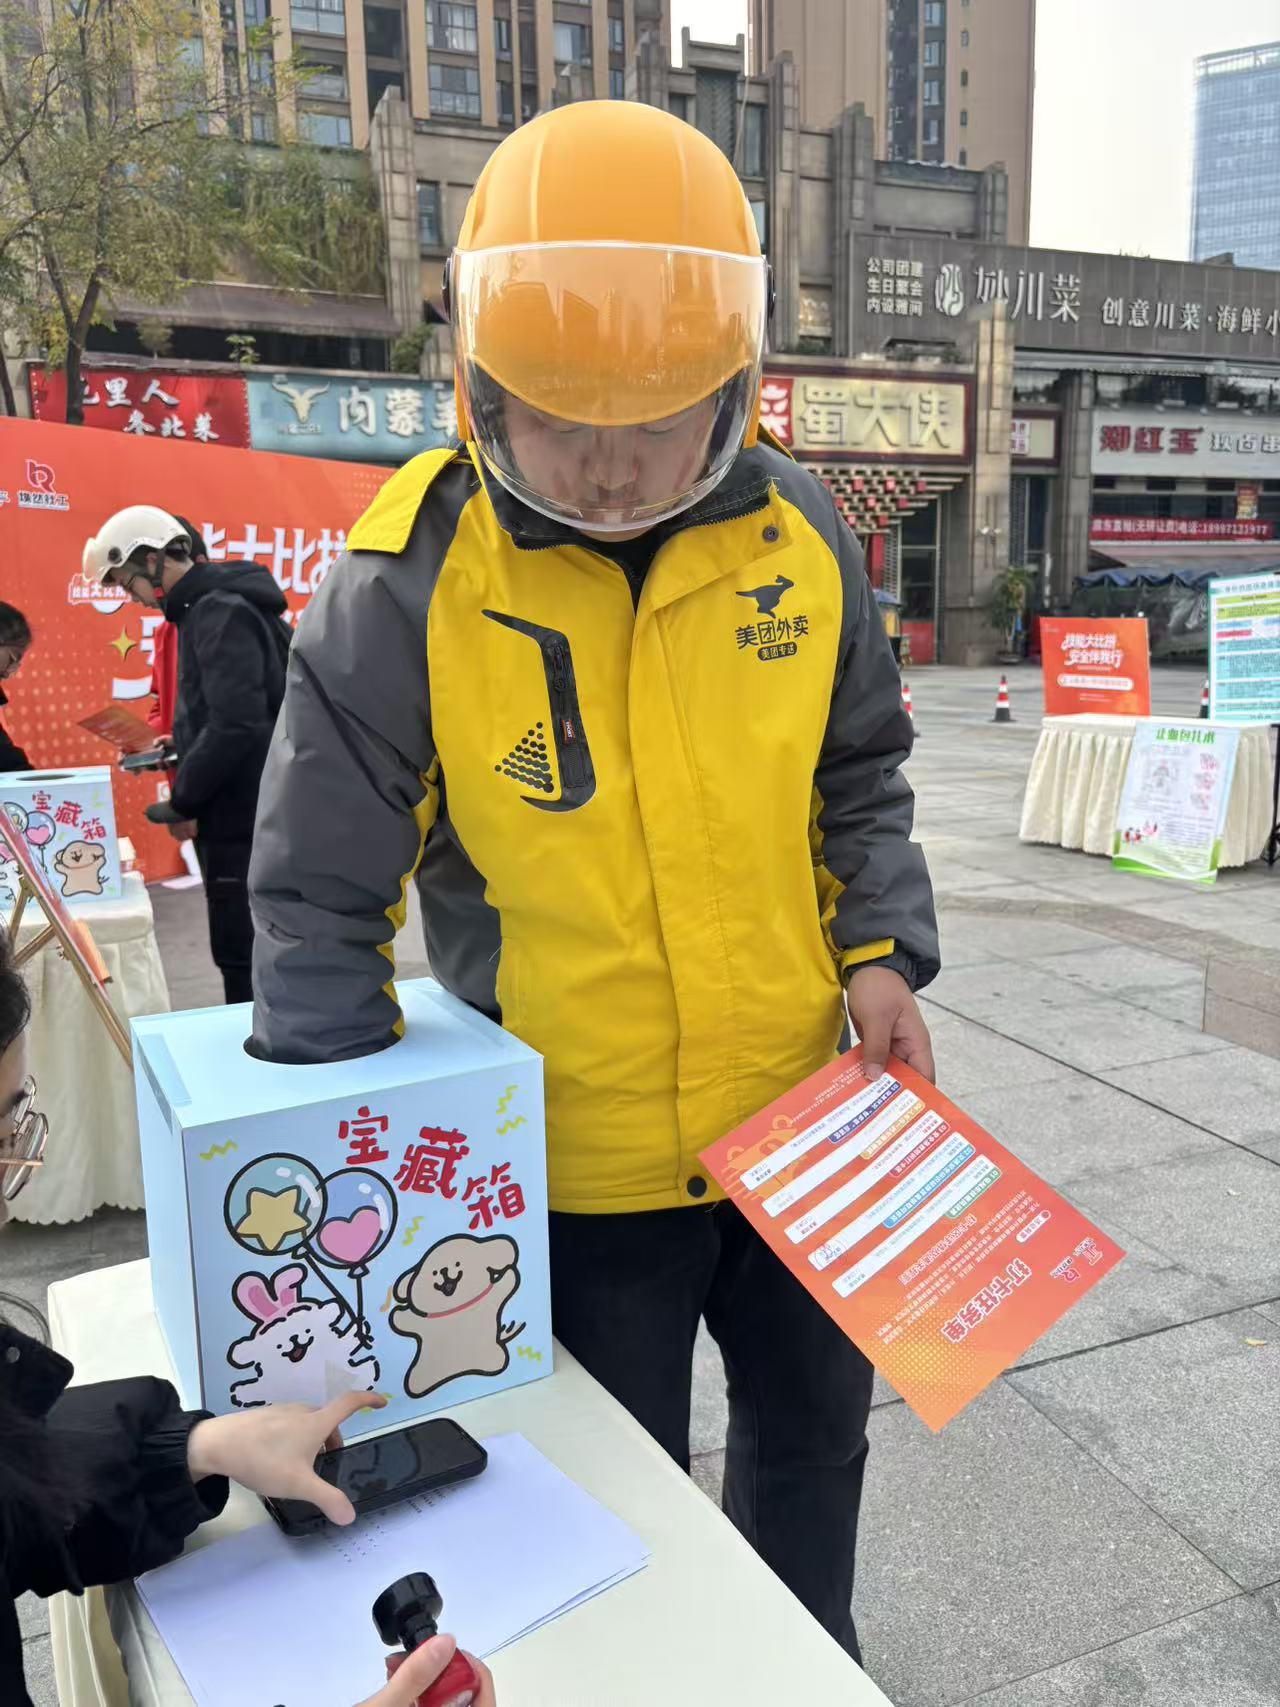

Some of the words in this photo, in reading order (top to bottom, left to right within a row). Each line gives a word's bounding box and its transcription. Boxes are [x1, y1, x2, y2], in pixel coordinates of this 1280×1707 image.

[867, 257, 923, 277] 公司团建
[867, 277, 922, 297] 生日聚会
[867, 298, 922, 317] 内设雅间
[800, 384, 952, 448] 蜀大侠
[736, 615, 809, 650] 美团外卖
[761, 642, 796, 660] 美团专送
[32, 790, 108, 841] 宝藏箱
[338, 1107, 526, 1230] 宝藏箱
[936, 1257, 1034, 1346] 打卡任务单
